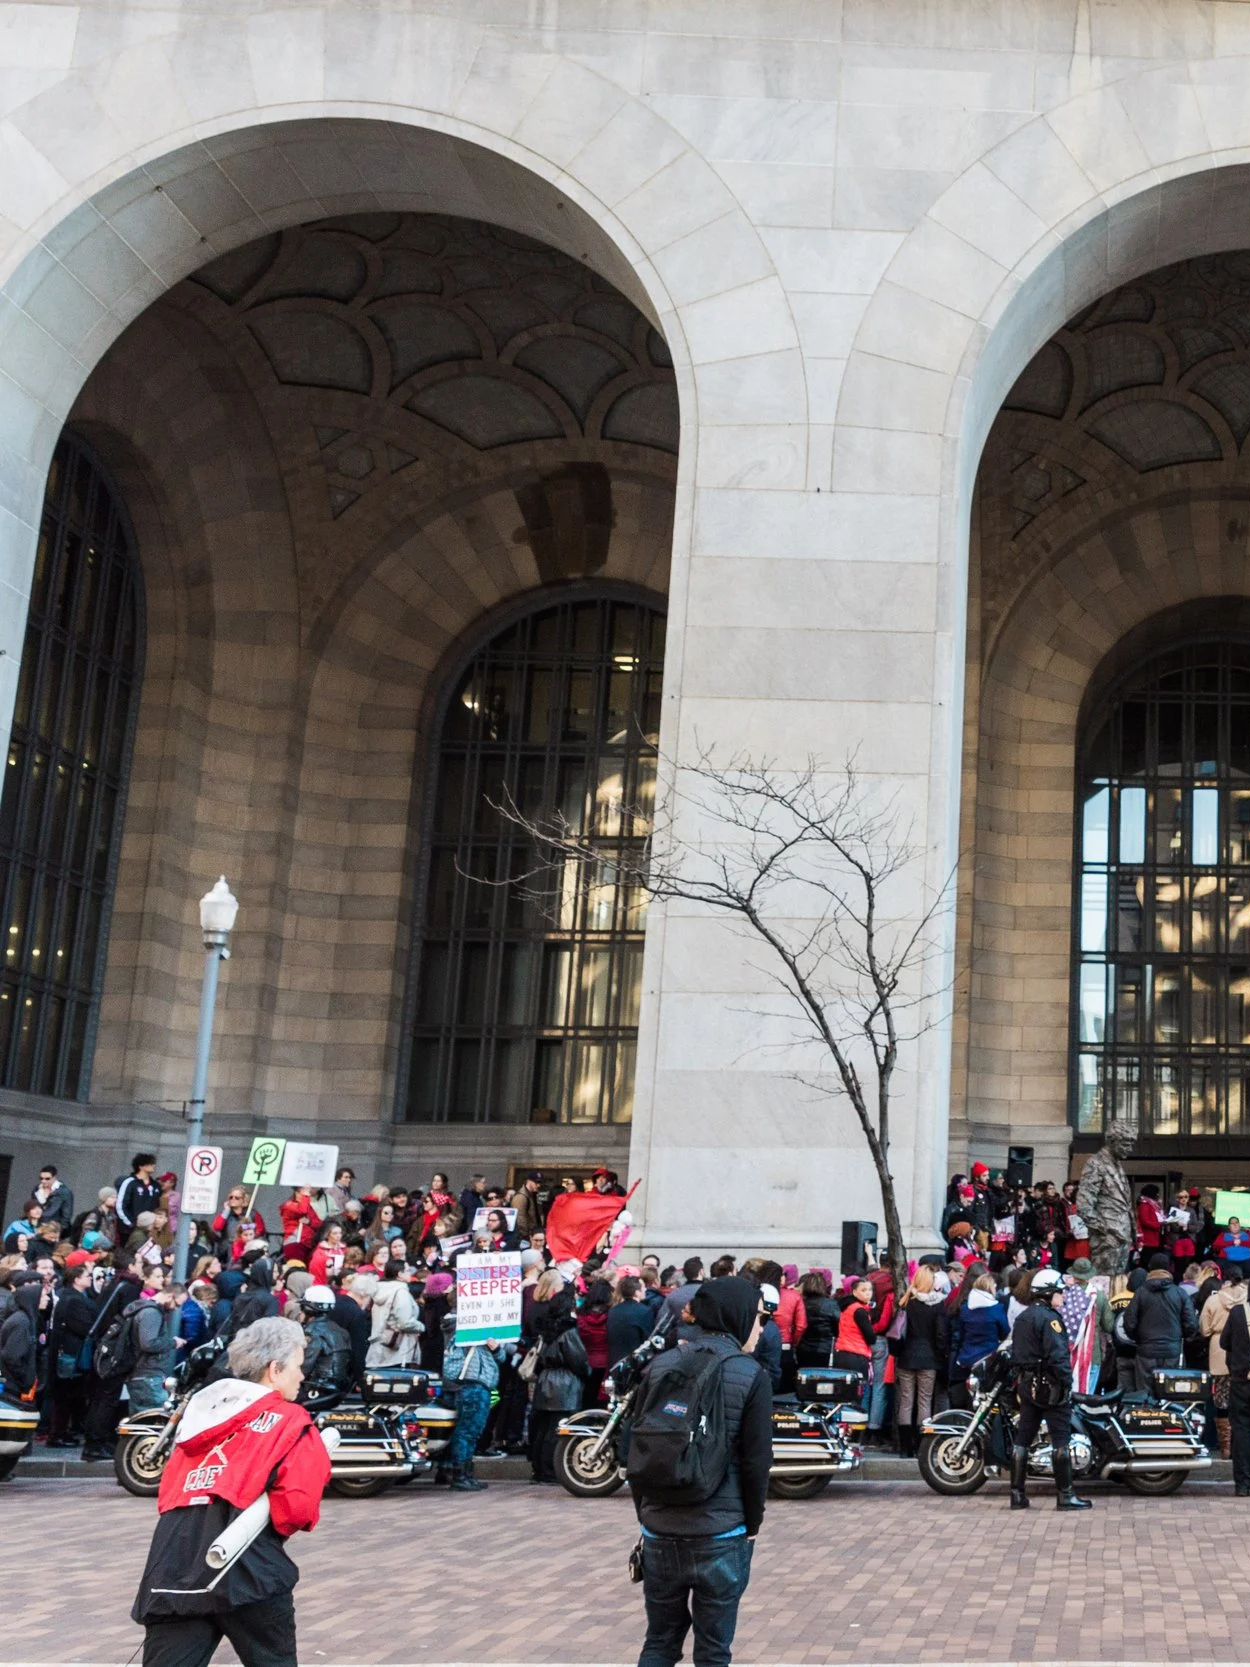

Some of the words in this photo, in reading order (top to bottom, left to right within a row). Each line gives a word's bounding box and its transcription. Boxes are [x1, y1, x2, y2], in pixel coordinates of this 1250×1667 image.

[478, 1257, 492, 1265] AM
[499, 1256, 511, 1265] MY
[457, 1265, 521, 1281] SISTERS
[457, 1279, 520, 1297] KEEPER
[461, 1301, 482, 1311] EVEN
[488, 1299, 494, 1308] IF
[501, 1298, 515, 1308] SHE
[457, 1315, 478, 1325] USED
[481, 1313, 491, 1323] TO
[494, 1313, 502, 1322] BE
[508, 1311, 519, 1321] MY
[243, 1411, 283, 1433] AN
[183, 1465, 226, 1493] CRE
